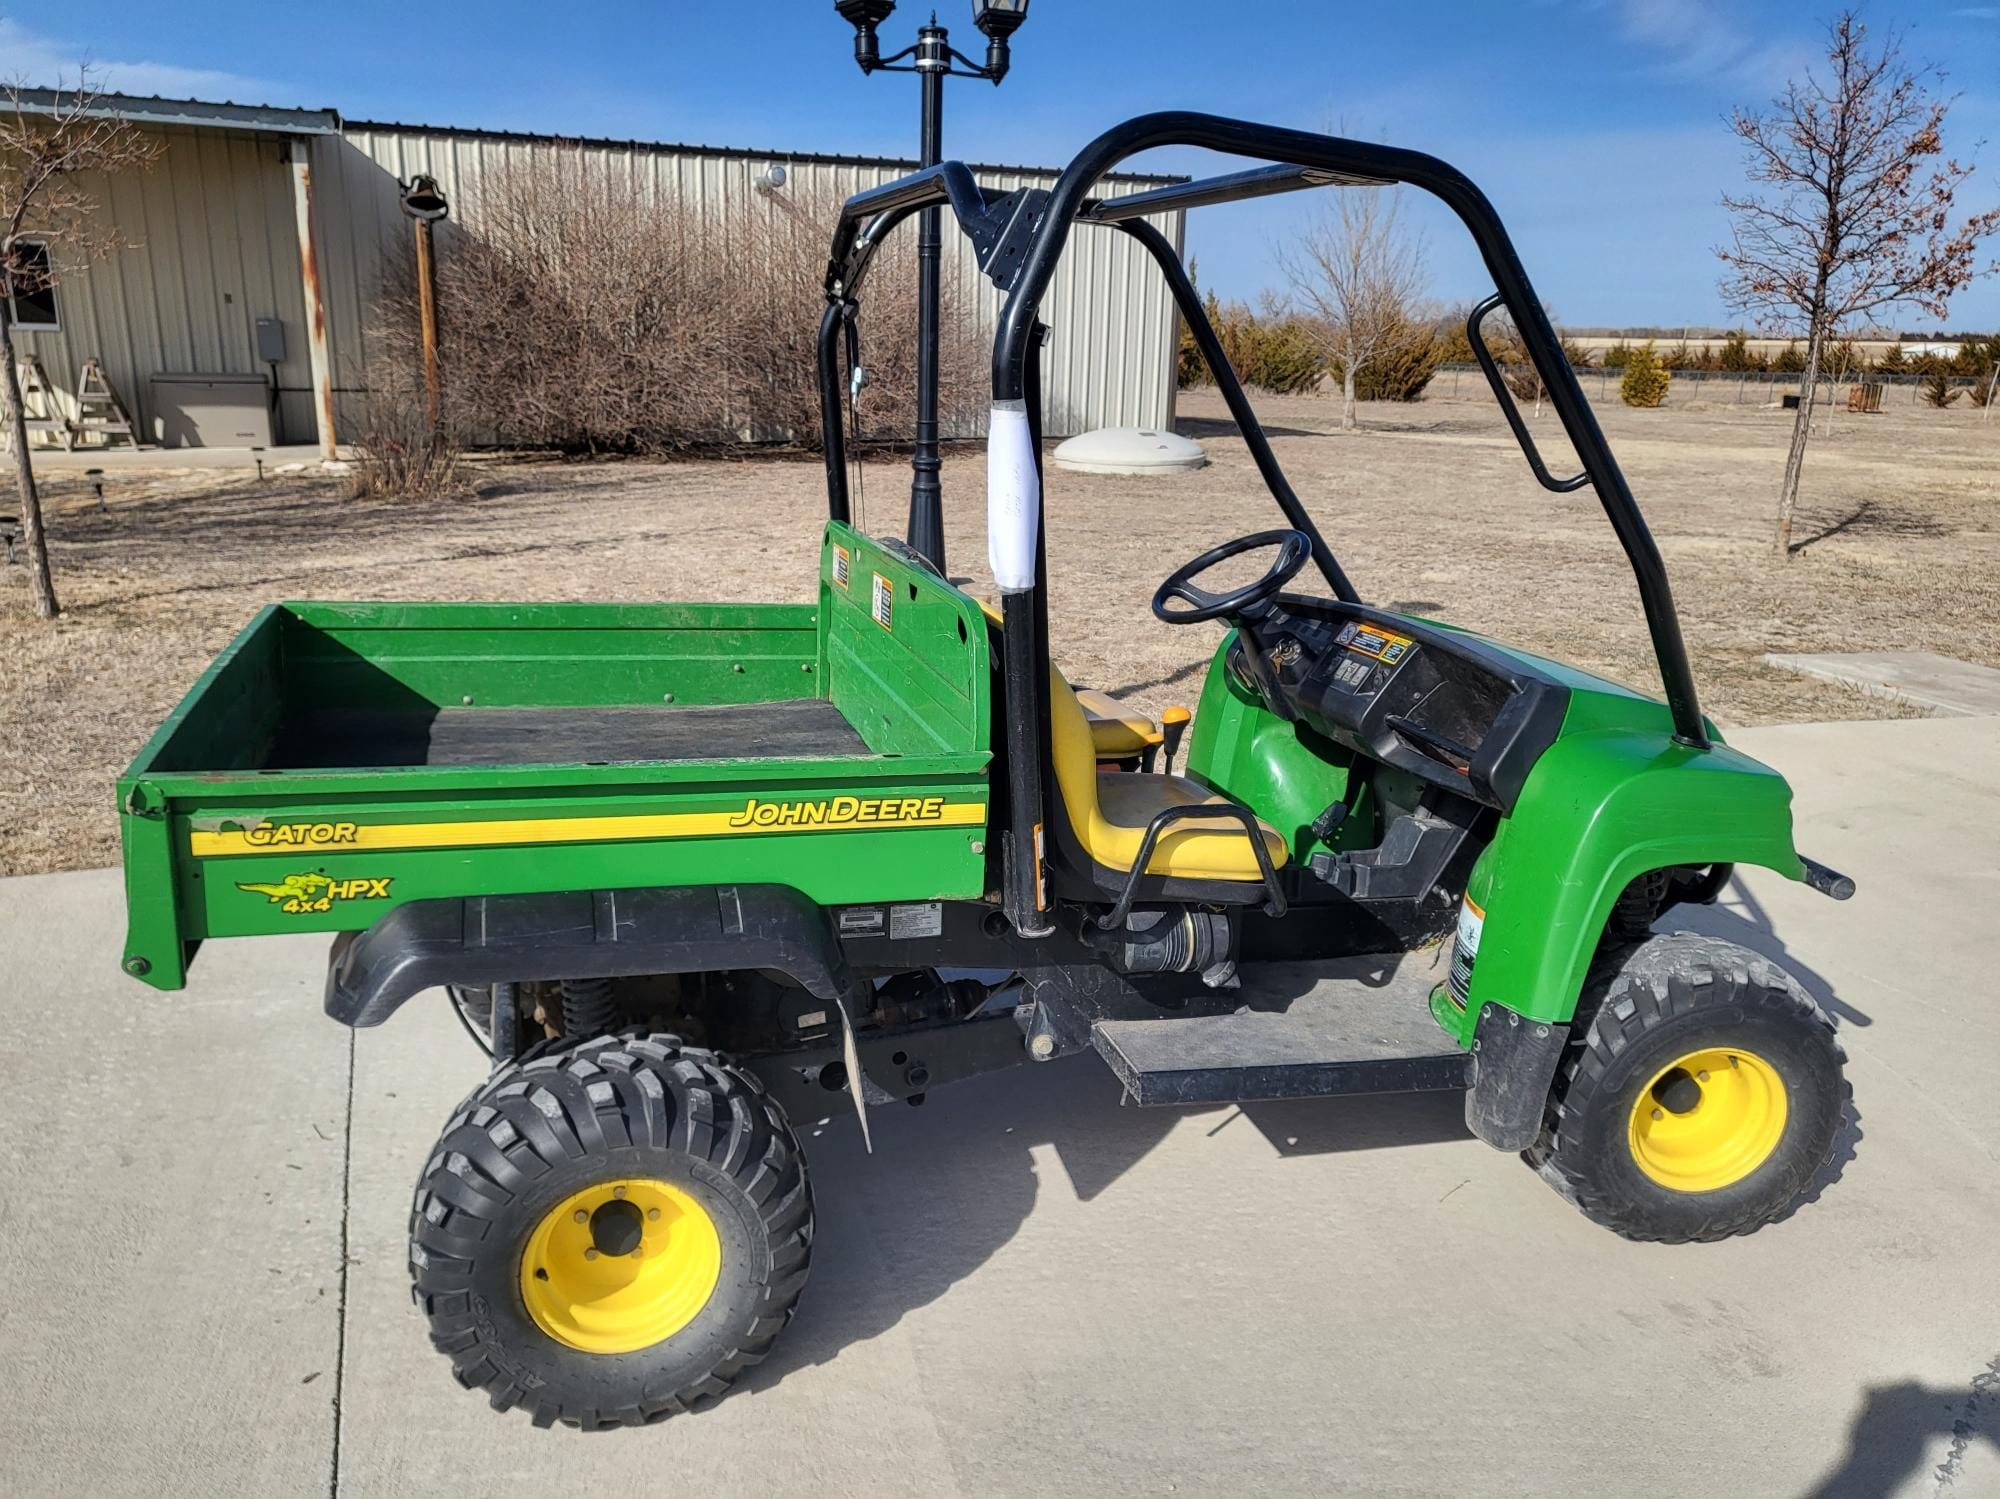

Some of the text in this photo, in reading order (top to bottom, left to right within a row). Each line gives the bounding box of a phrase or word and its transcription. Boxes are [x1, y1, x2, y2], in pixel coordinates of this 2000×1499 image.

[729, 796, 944, 827] JOHN DEERE
[244, 821, 357, 846] GATOR
[327, 877, 394, 900] HPX
[281, 897, 332, 914] 4x4
